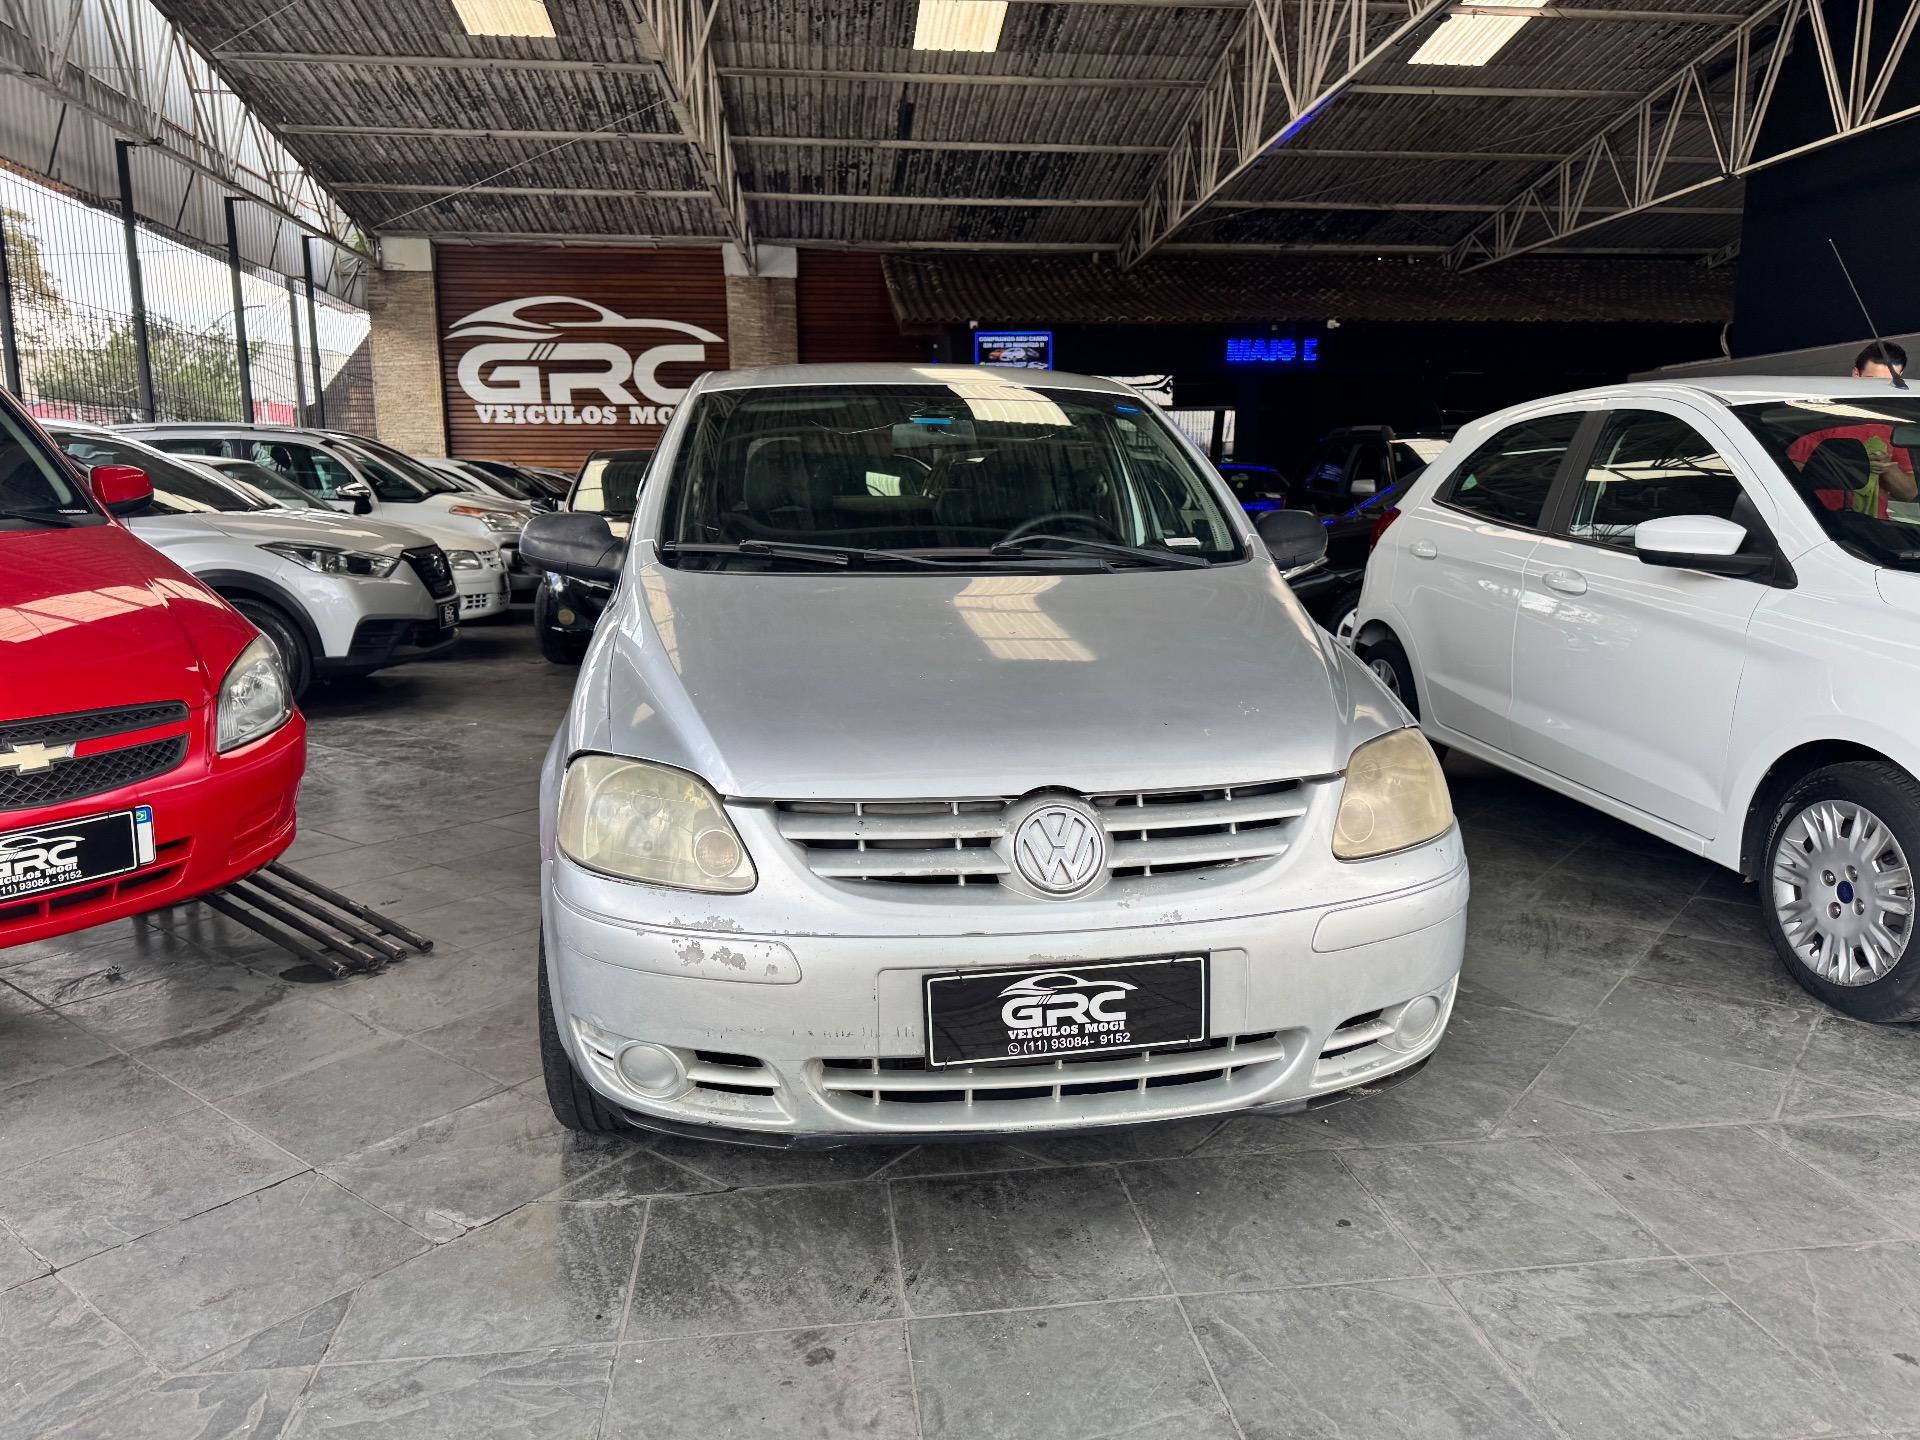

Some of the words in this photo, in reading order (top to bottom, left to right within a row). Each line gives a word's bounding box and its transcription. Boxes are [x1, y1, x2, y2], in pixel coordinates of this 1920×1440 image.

[457, 342, 706, 405] GRC
[474, 405, 617, 424] VEICULOS
[46, 863, 78, 875] MOGI
[0, 884, 18, 894] 11)
[19, 879, 50, 890] 93084
[58, 870, 82, 882] 9152
[1001, 990, 1126, 1028] GRC
[1008, 1024, 1079, 1040] VEICULOS
[1085, 1020, 1125, 1034] MOGI
[1023, 1040, 1048, 1053] (11)
[1100, 1033, 1131, 1045] 9152
